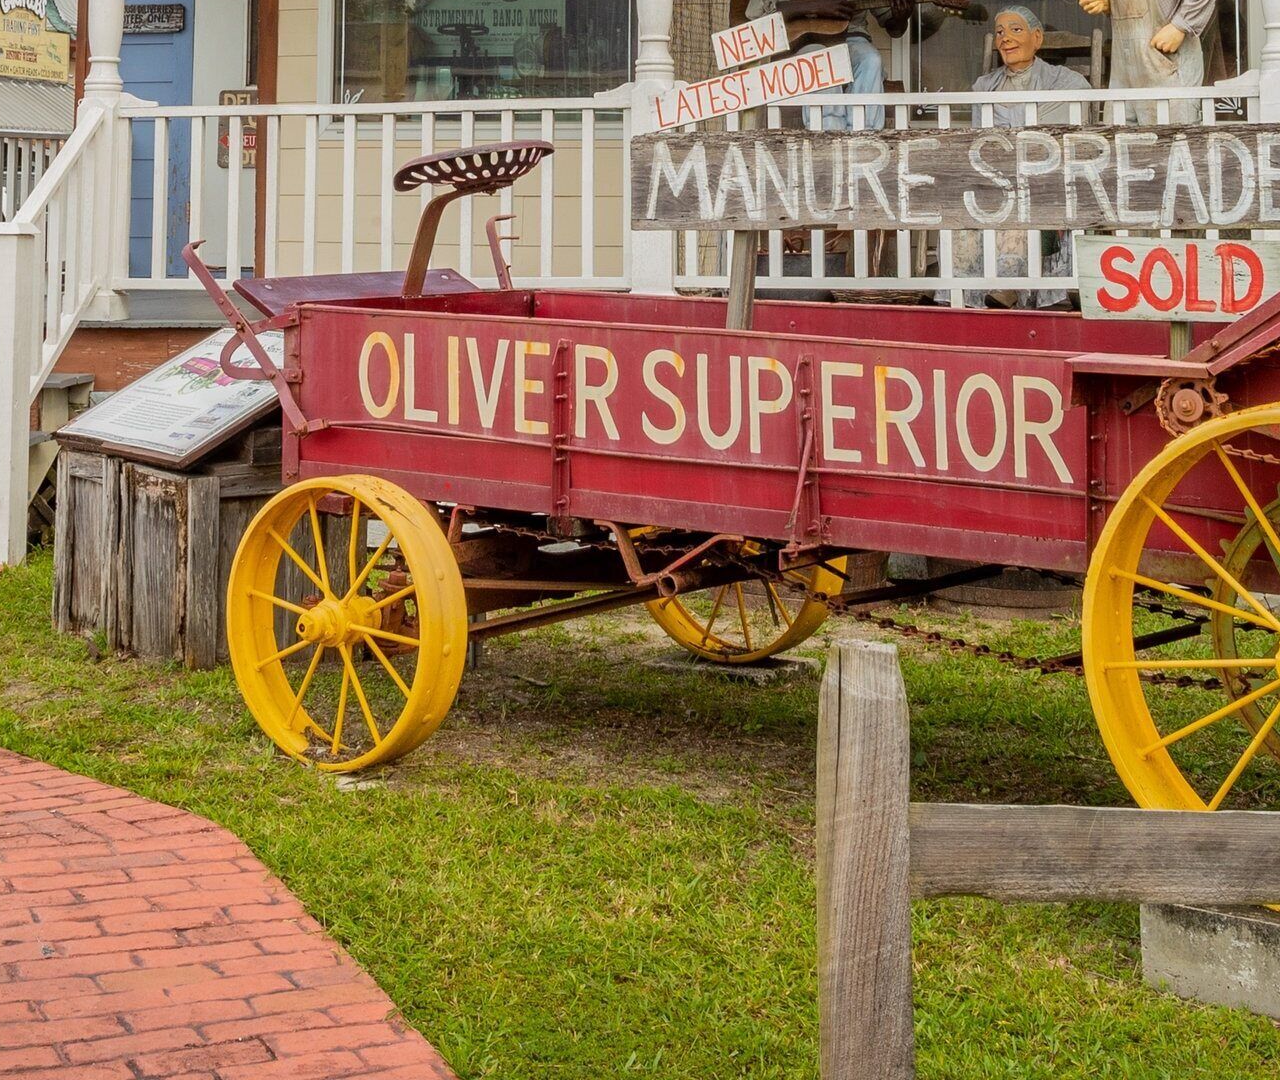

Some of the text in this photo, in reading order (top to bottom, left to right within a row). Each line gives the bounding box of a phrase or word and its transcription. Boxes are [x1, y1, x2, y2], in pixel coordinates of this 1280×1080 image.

[718, 18, 777, 67] NEW
[655, 51, 846, 128] LATEST MODEL
[647, 137, 942, 224] MANURE
[1098, 242, 1264, 314] SOLD
[358, 330, 1074, 485] OLIVER SUPERIOR
